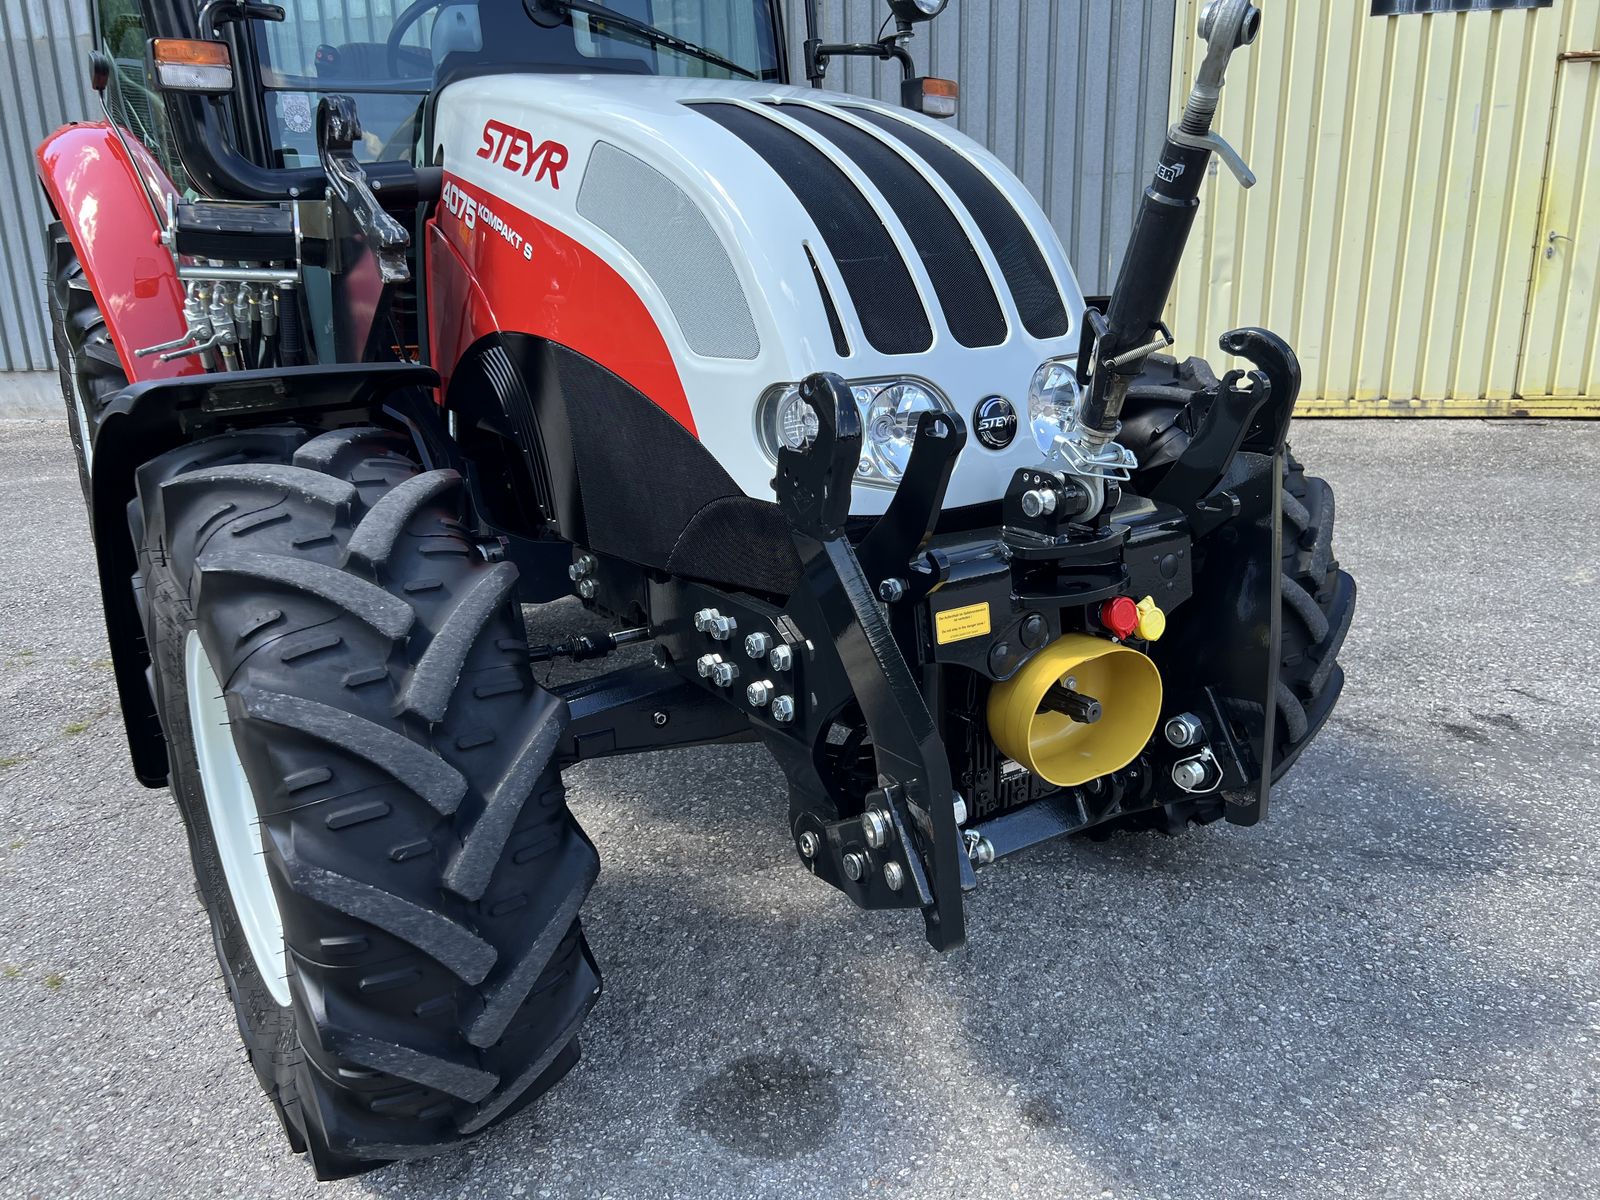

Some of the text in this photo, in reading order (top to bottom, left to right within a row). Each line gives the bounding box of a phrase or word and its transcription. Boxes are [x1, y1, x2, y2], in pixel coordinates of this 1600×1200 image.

[476, 119, 569, 190] STEYR
[442, 181, 533, 261] 4075 KOMPAKT S
[977, 415, 1016, 431] STEYR
